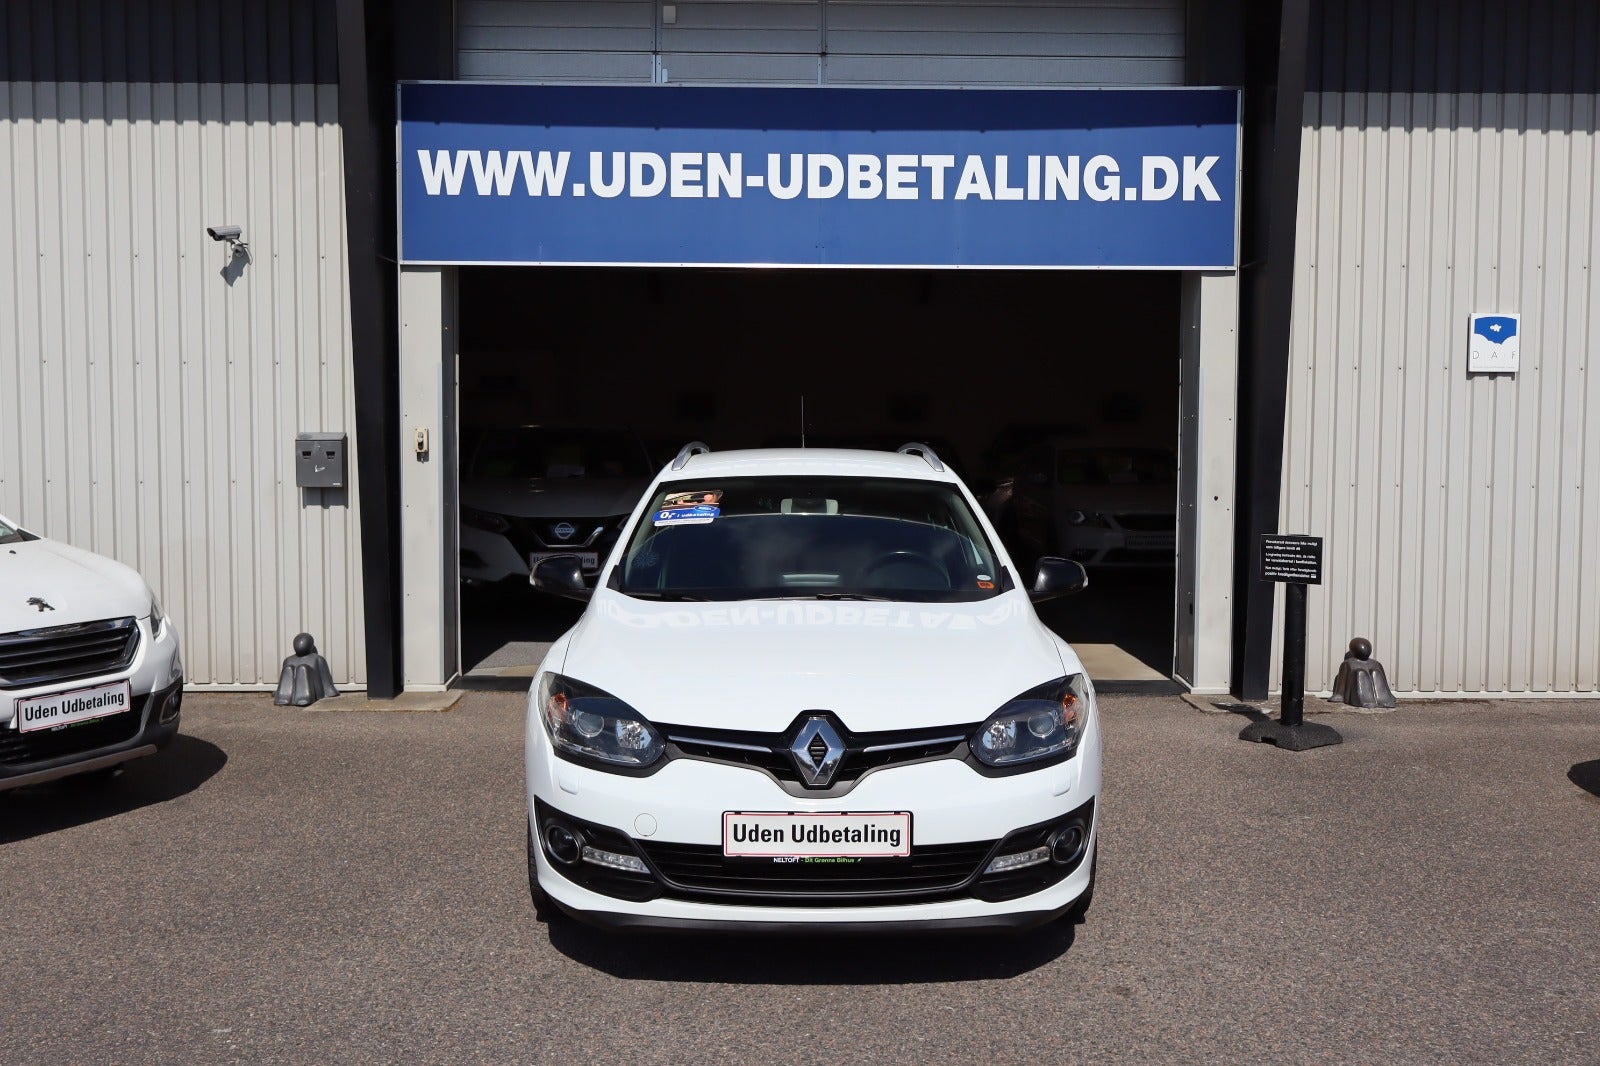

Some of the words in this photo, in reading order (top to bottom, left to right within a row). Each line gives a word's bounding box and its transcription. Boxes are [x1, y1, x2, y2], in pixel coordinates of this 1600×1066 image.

[418, 149, 1221, 202] WWW.UDEN-UDBETALING.DK
[25, 705, 58, 722] Uden
[61, 692, 124, 715] Udbetaling
[733, 823, 785, 843] Uden
[791, 824, 901, 847] Udbetaling
